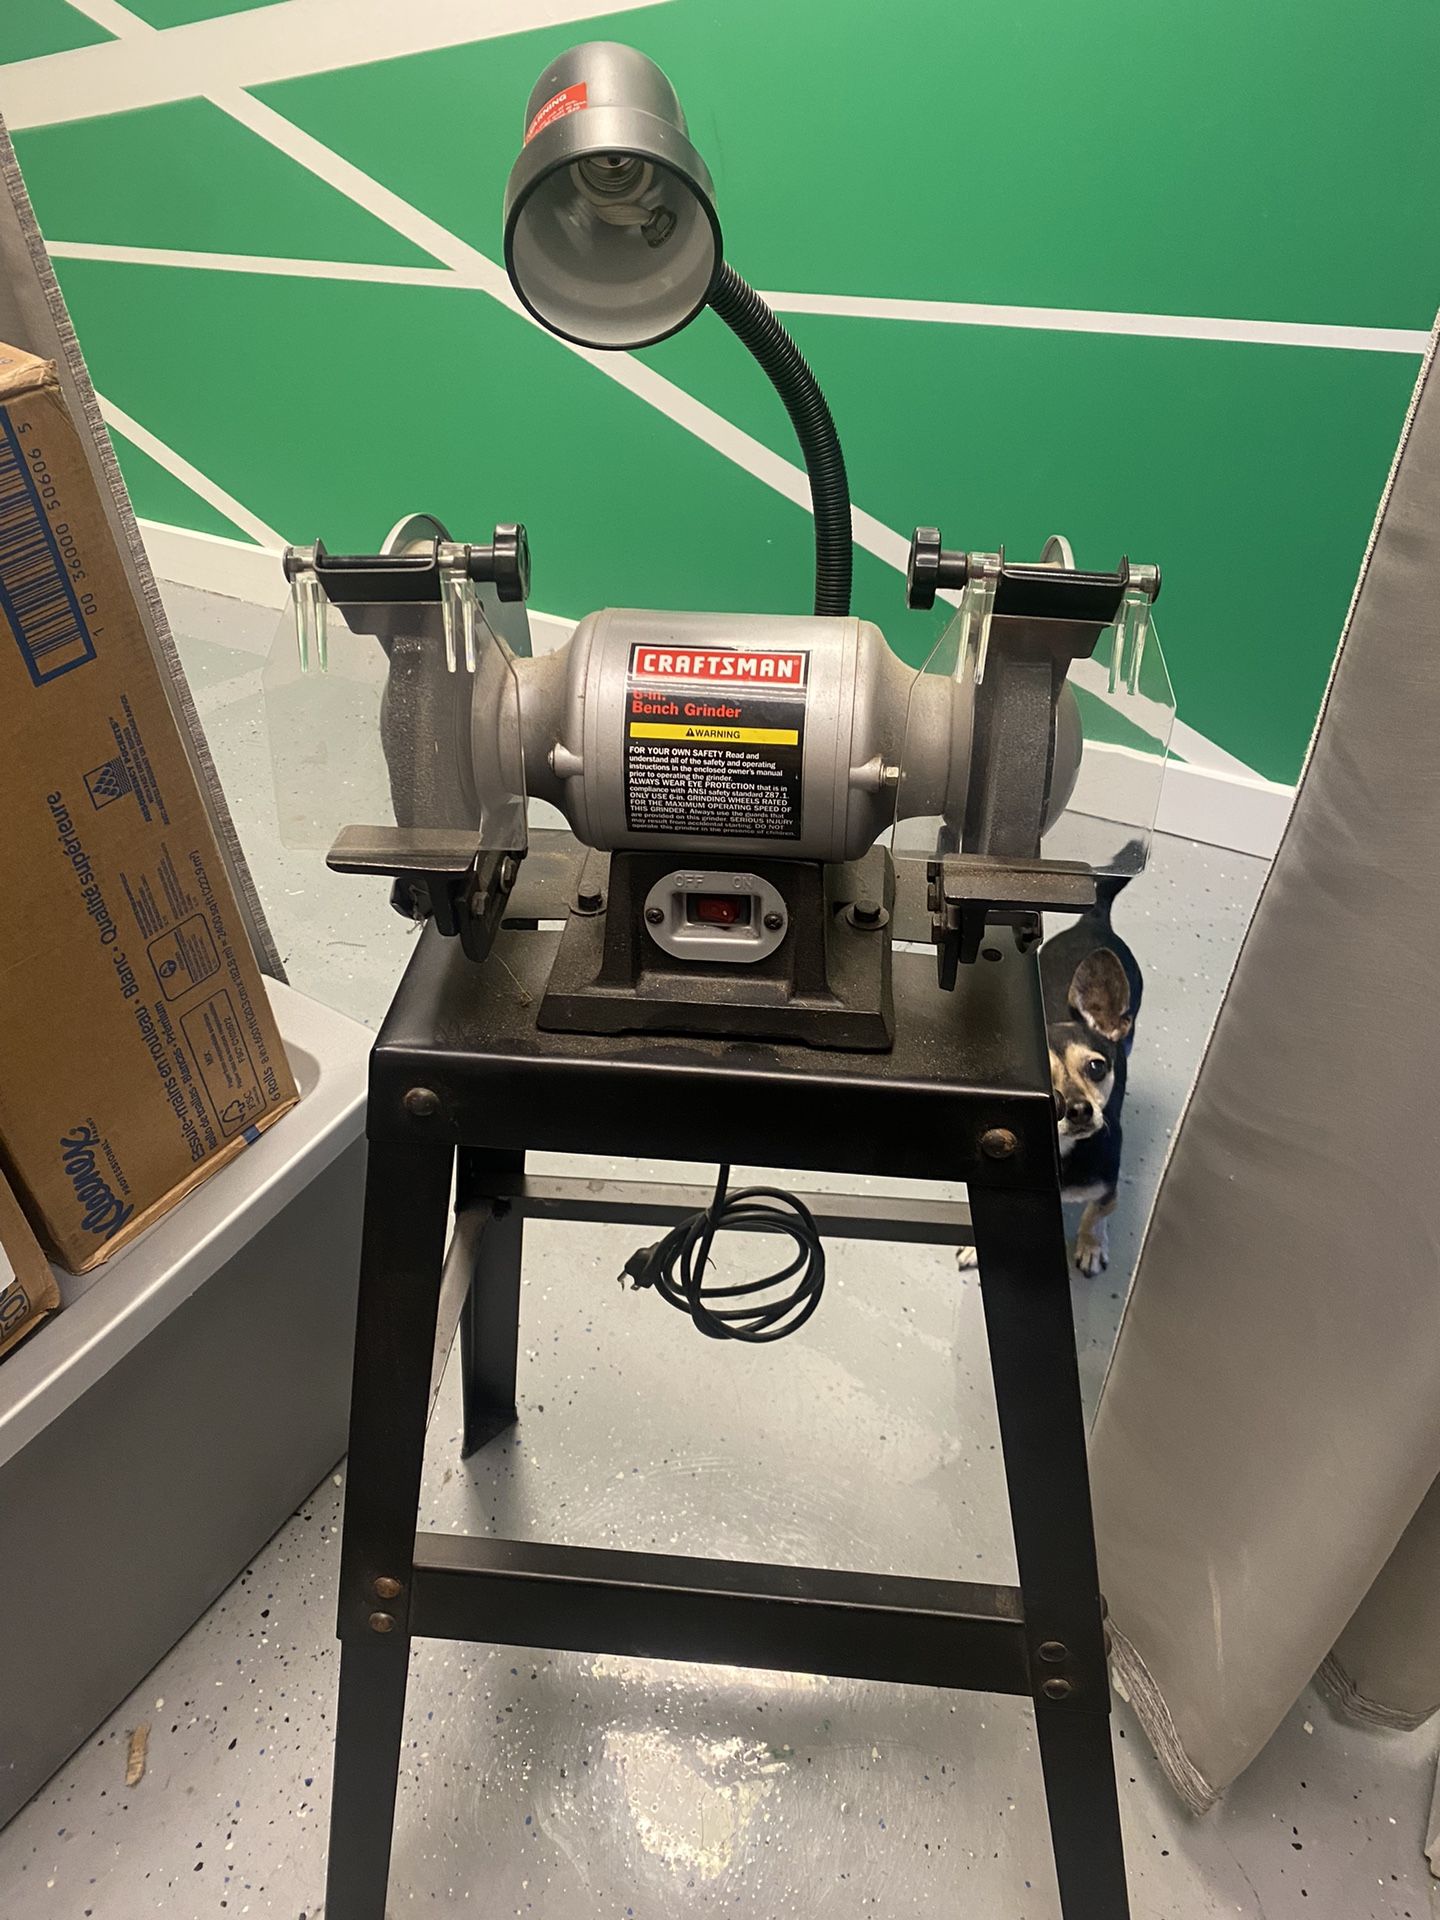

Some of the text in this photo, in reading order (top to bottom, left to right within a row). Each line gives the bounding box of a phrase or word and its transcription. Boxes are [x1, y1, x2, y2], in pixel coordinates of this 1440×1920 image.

[17, 422, 32, 434] 5
[27, 447, 60, 511] 50606
[55, 523, 86, 583] 36000
[80, 593, 97, 615] 00
[643, 654, 793, 678] CRAFTSMAN
[632, 701, 741, 718] Bench Grinder
[696, 728, 740, 739] WARNING
[648, 747, 670, 755] YOUR
[672, 748, 690, 756] OWN
[693, 749, 723, 757] SAFETY
[726, 751, 745, 759] Read
[703, 759, 725, 767] safety
[742, 761, 776, 769] operating
[657, 772, 690, 780] operating
[705, 781, 755, 790] PROTECTION
[687, 795, 726, 803] GRINDING
[674, 873, 754, 889] OFF ON
[211, 915, 227, 940] 2400
[46, 790, 206, 1162] Essuie-mains en rouleau Blanc Qualité supérieure
[238, 986, 248, 1001] cm
[260, 1055, 269, 1064] 8
[262, 1066, 279, 1095] Rolls
[270, 1092, 281, 1101] 6
[199, 1114, 210, 1128] de
[98, 1138, 132, 1195] PROFESSIONAL
[60, 1125, 135, 1240] Kleenex
